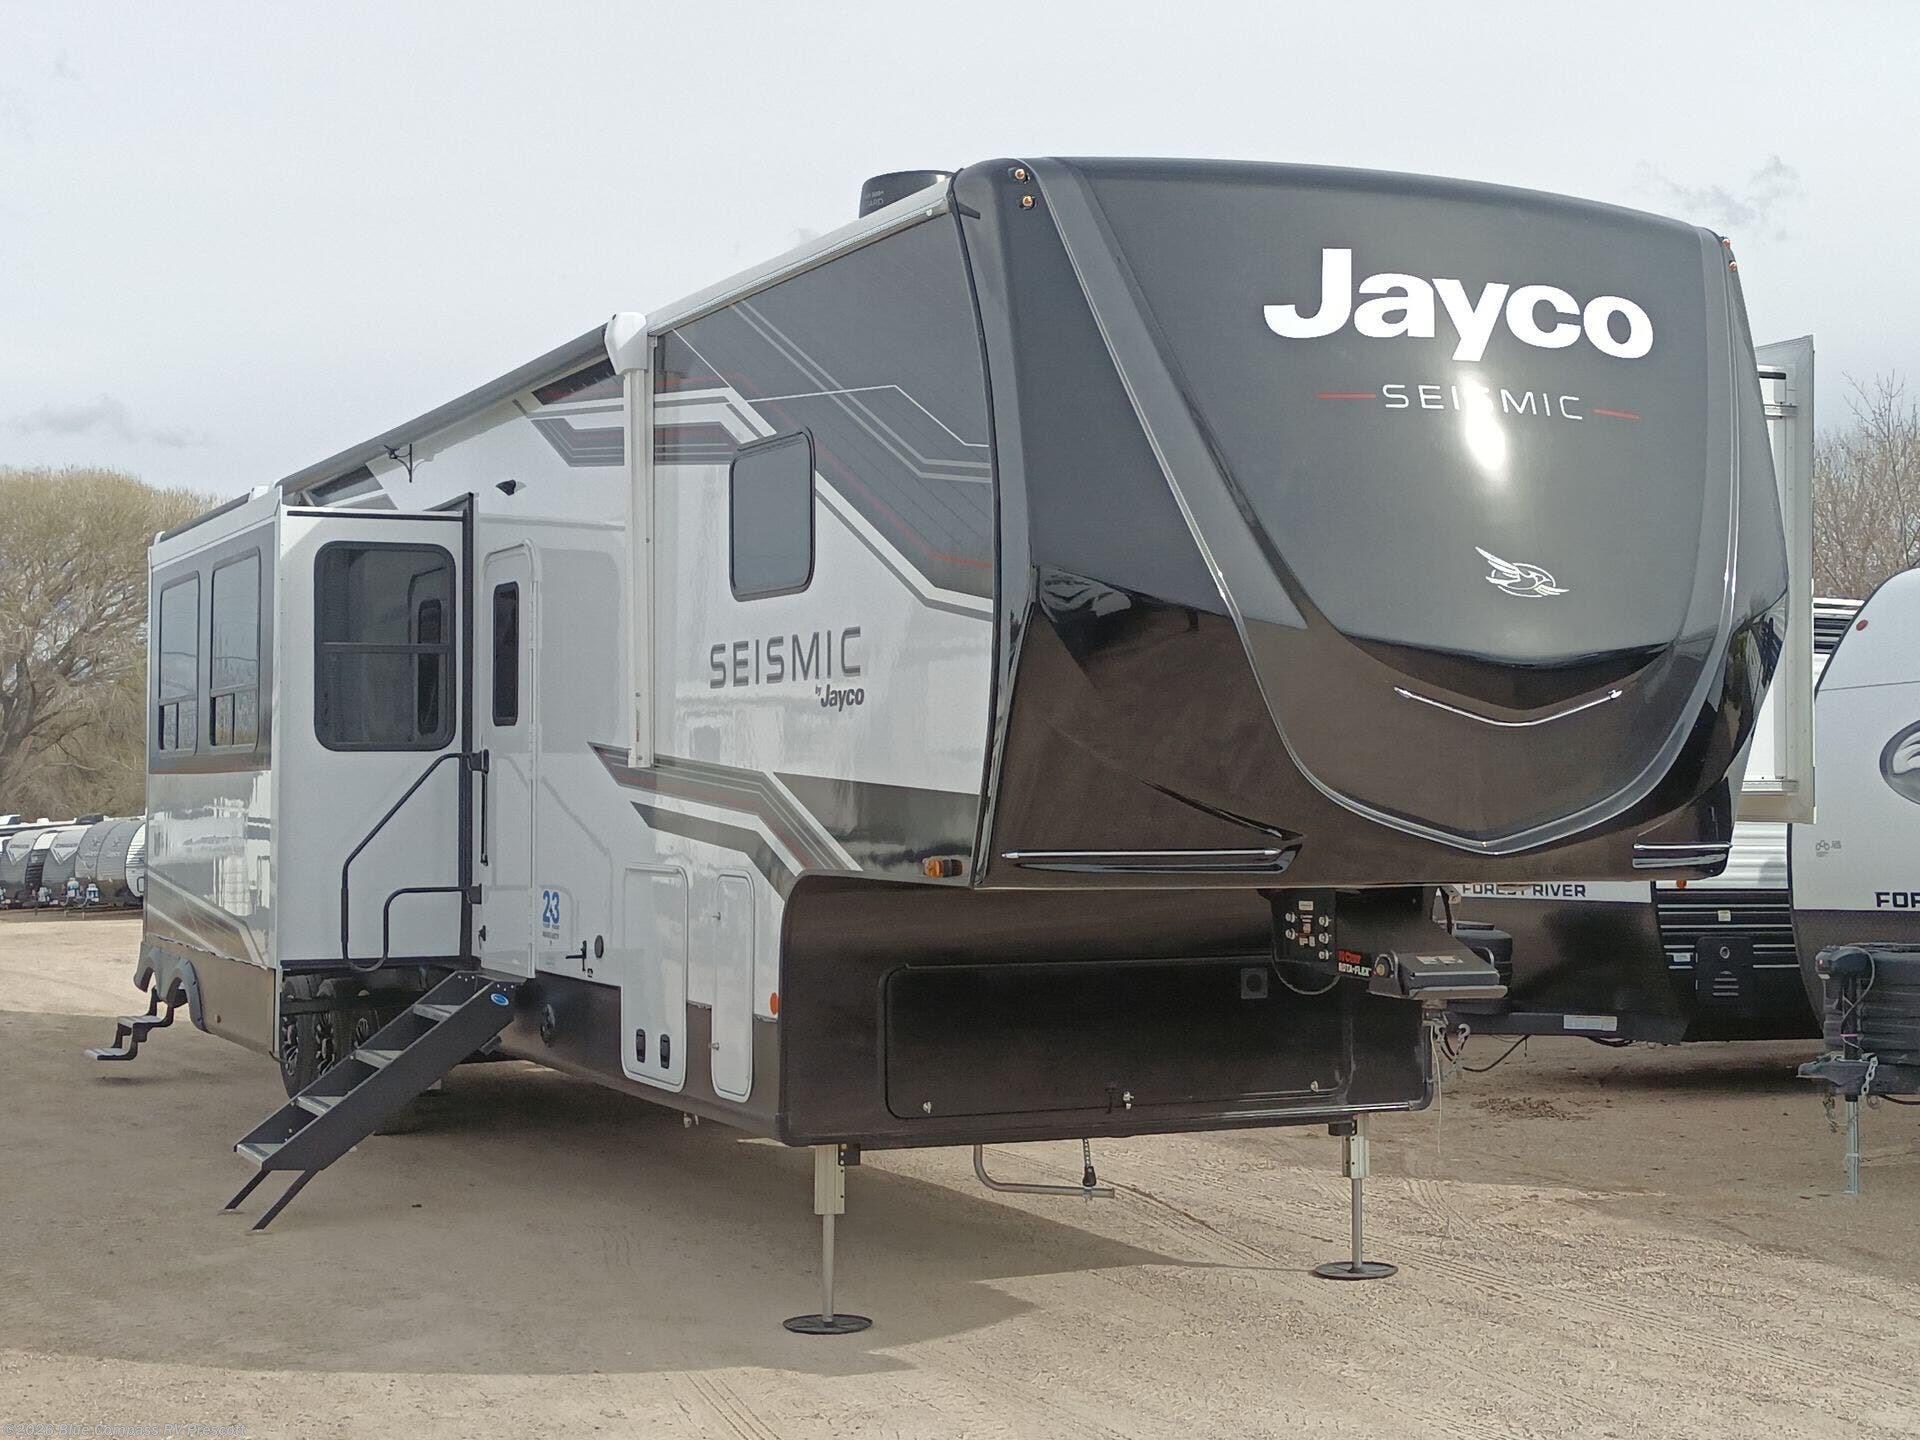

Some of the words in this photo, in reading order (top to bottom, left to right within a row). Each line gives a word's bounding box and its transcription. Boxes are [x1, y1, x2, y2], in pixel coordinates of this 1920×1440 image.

[1263, 247, 1654, 362] Jayco
[710, 626, 861, 689] SEISMIC
[821, 684, 865, 712] Jayco
[1532, 884, 1587, 898] RIVER
